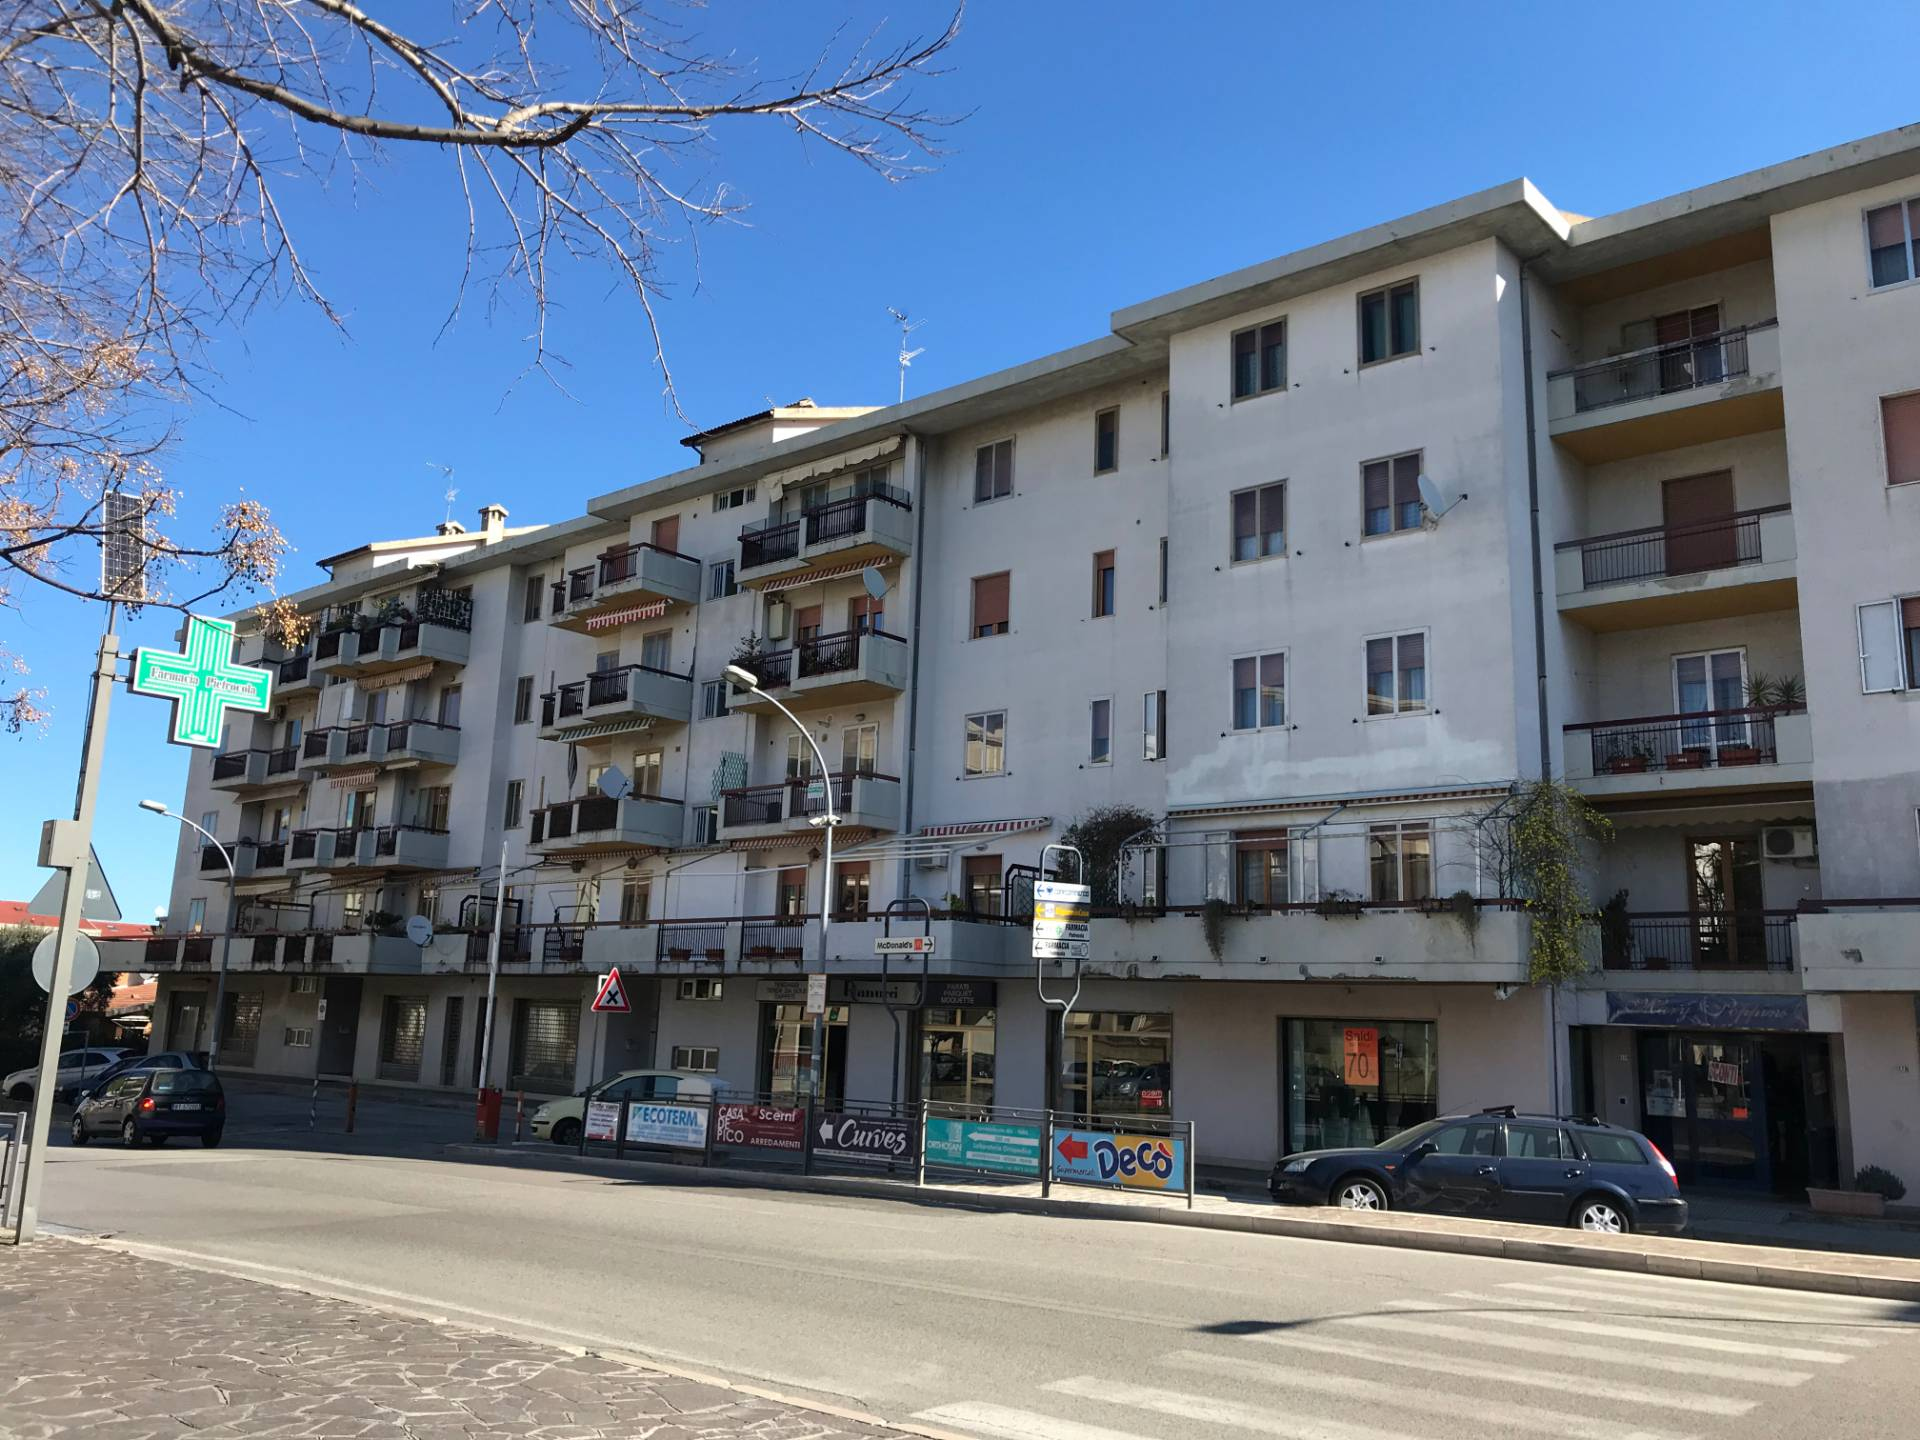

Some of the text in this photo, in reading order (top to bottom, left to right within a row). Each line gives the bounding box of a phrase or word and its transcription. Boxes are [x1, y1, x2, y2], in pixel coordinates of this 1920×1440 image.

[151, 666, 199, 686] Farmacia
[1065, 923, 1088, 932] FARMACIA
[876, 940, 913, 950] McDonald's
[642, 1106, 698, 1127] ECOTERM
[718, 1106, 745, 1120] CASA
[717, 1117, 731, 1130] DE
[716, 1129, 745, 1143] PICO
[837, 1118, 907, 1155] Curves
[750, 1137, 801, 1150] ARREDAMENTI
